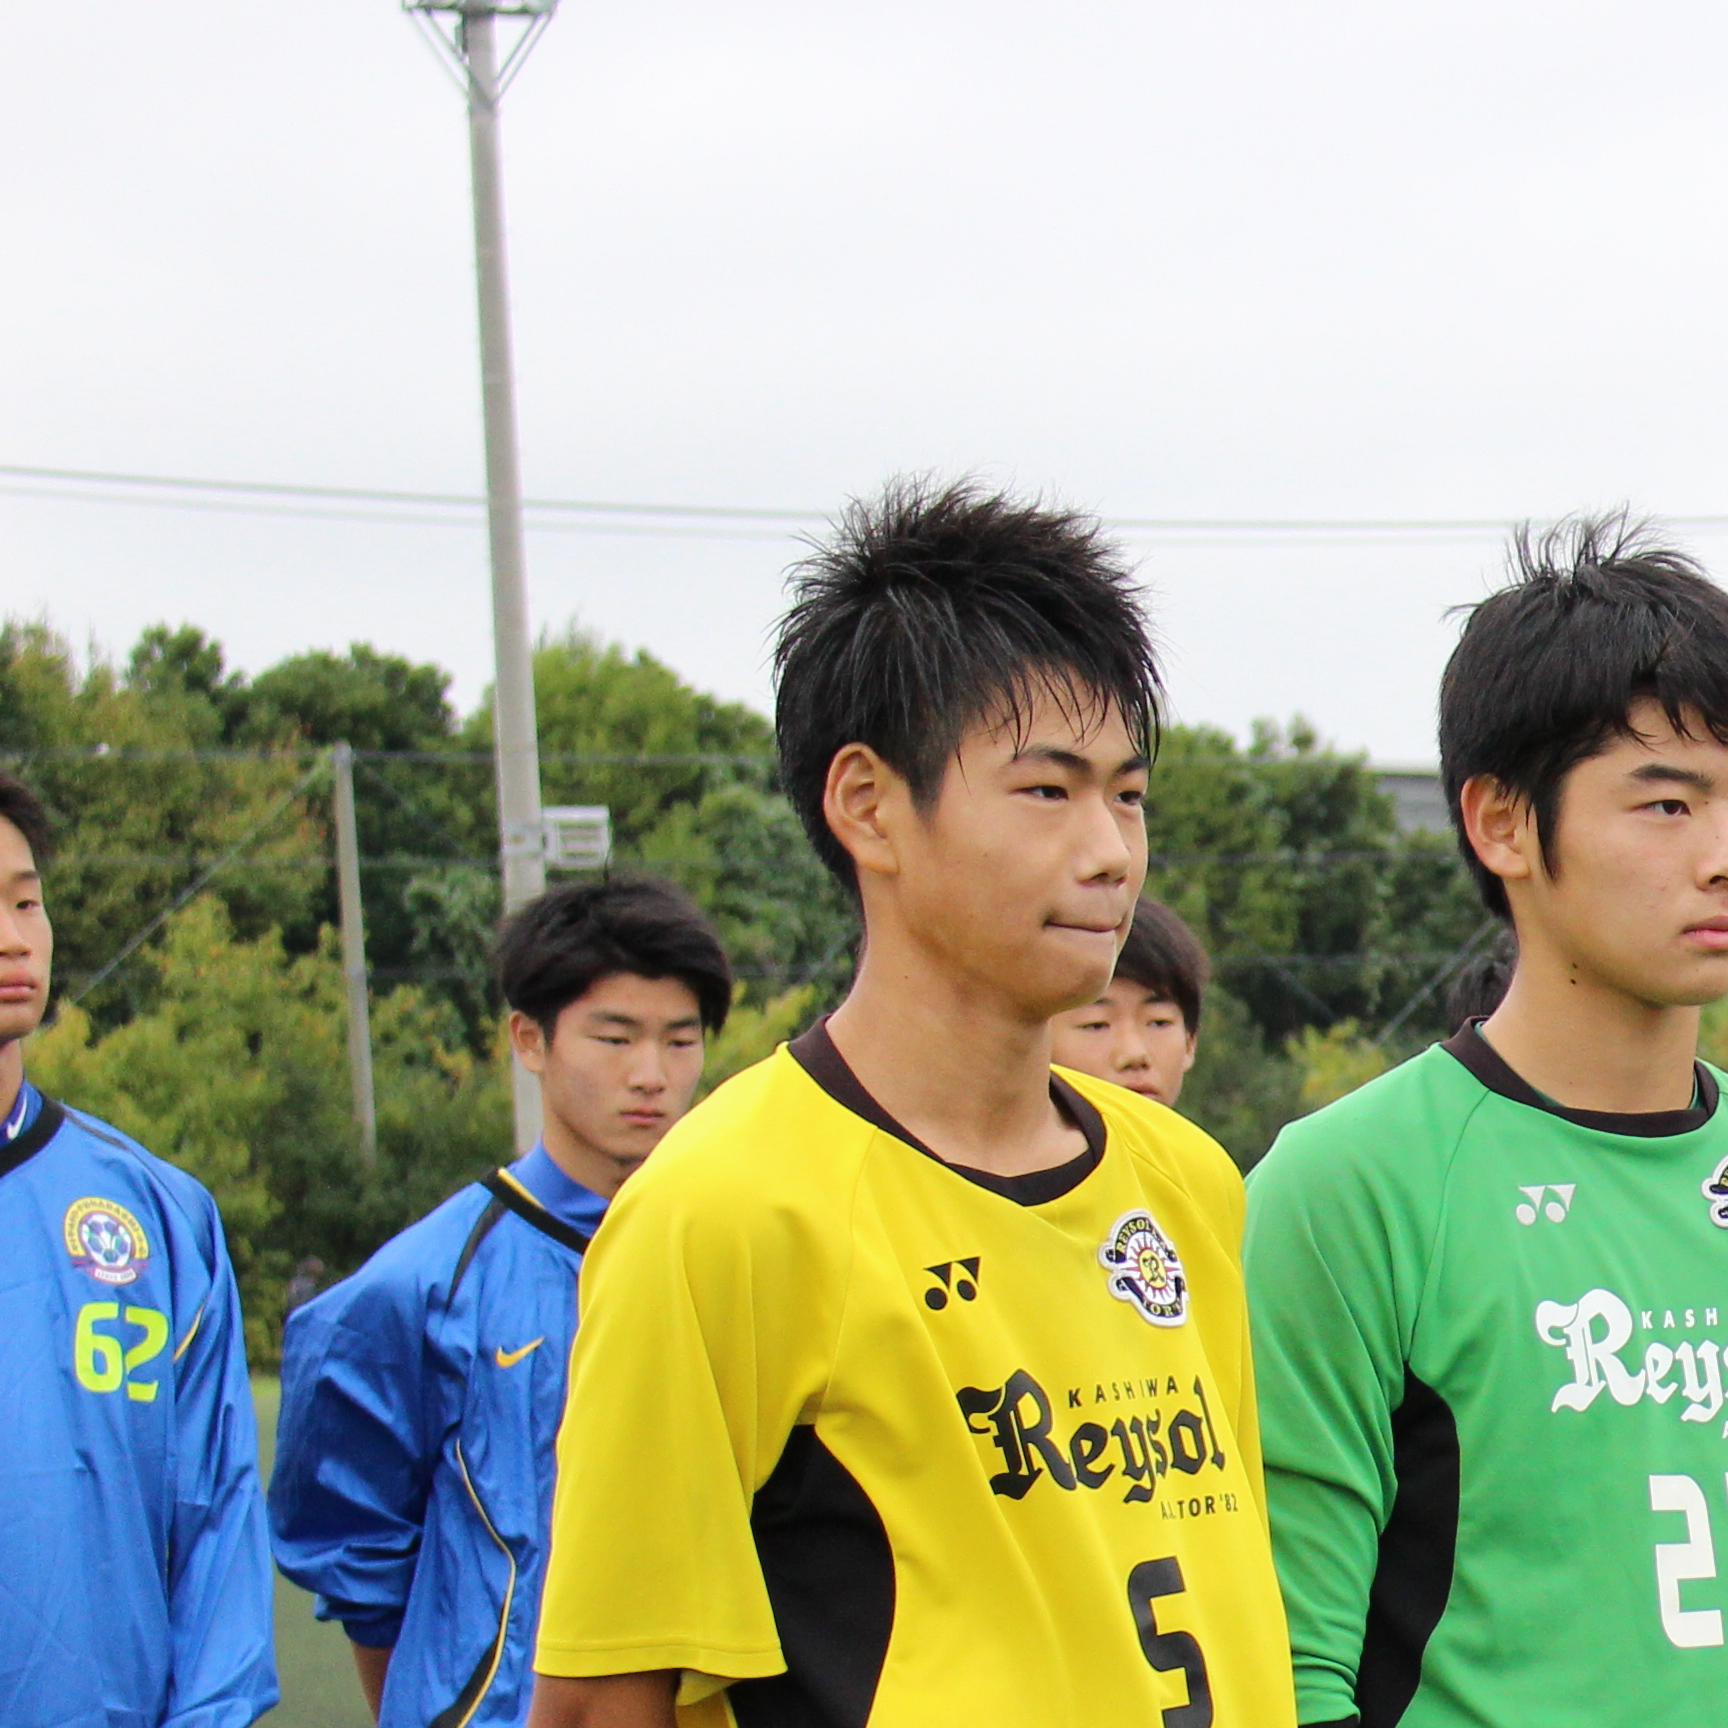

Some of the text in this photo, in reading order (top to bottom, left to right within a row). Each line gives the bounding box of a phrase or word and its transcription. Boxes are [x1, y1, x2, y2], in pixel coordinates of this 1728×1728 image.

[74, 1302, 169, 1402] 62
[1068, 1376, 1178, 1408] KASHIWA
[956, 1368, 1226, 1504] Reysol
